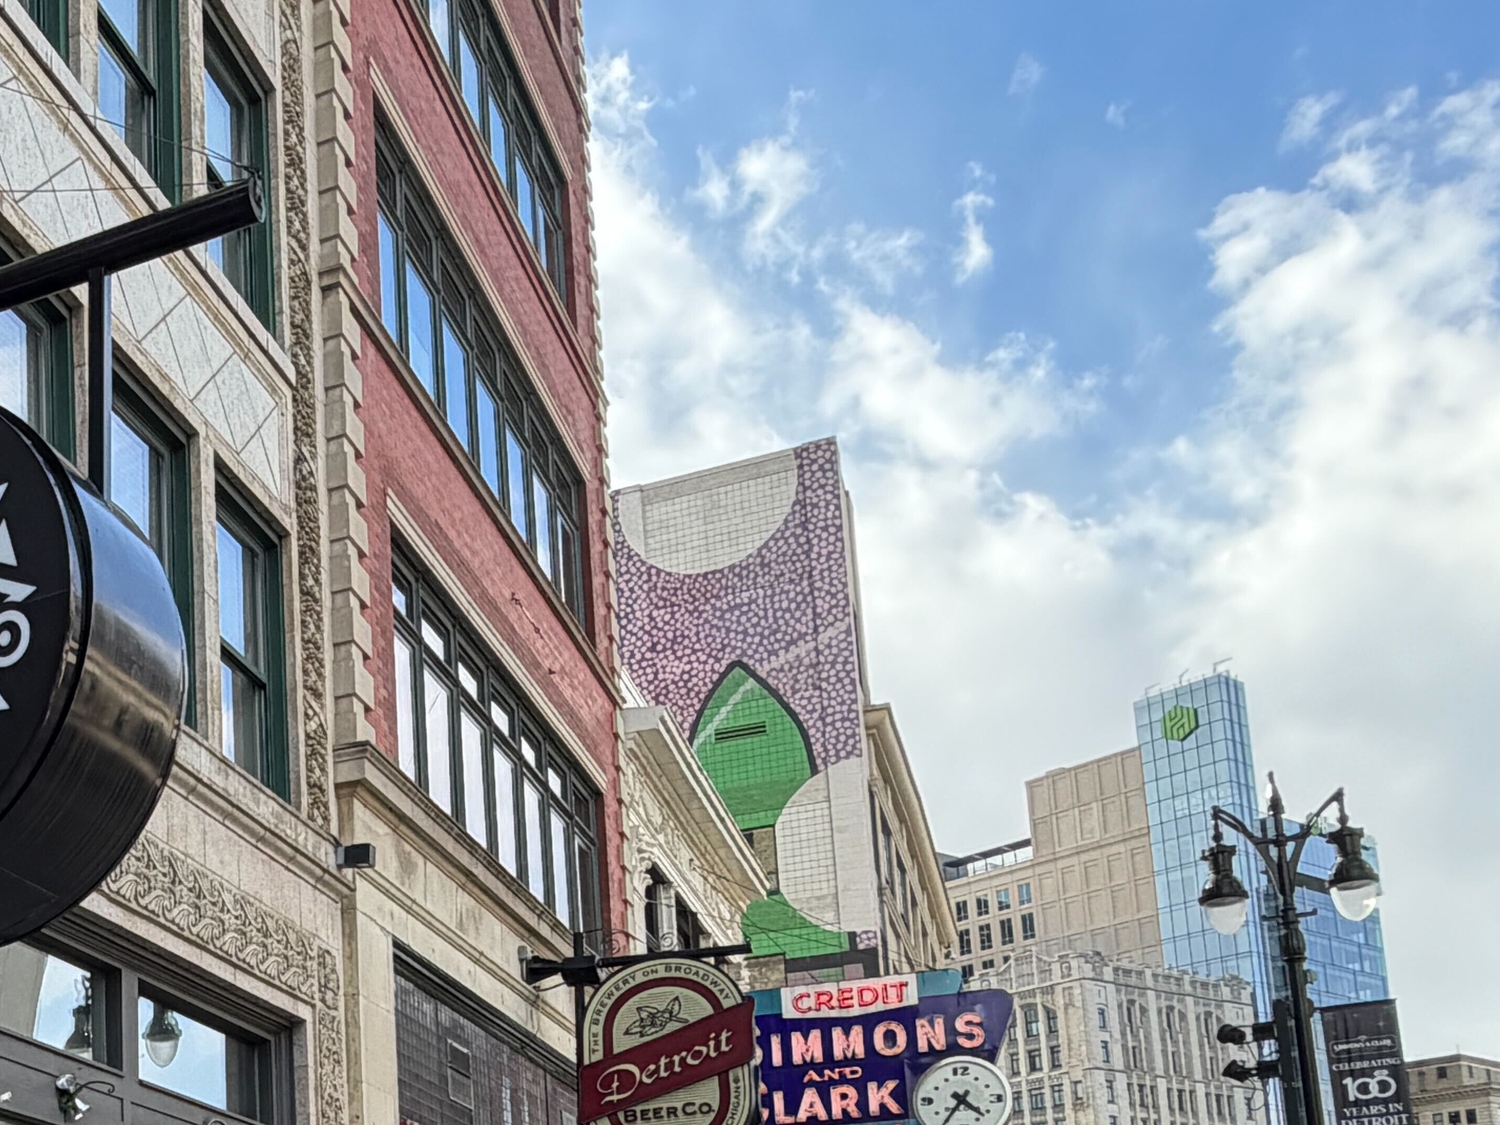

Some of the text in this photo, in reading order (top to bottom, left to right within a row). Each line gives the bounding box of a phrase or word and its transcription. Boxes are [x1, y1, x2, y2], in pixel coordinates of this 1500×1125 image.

[792, 981, 909, 1014] CREDIT
[591, 965, 733, 1055] THE BREWERY ON BROADWAY
[755, 1011, 986, 1067] IMMONS
[596, 1028, 734, 1105] Detroit
[803, 1066, 863, 1083] AND
[952, 1066, 971, 1077] 12
[1332, 1057, 1402, 1071] CELEBRATING
[1342, 1072, 1397, 1102] 100
[624, 1106, 679, 1123] BEER
[1343, 1102, 1404, 1117] YEARS IN
